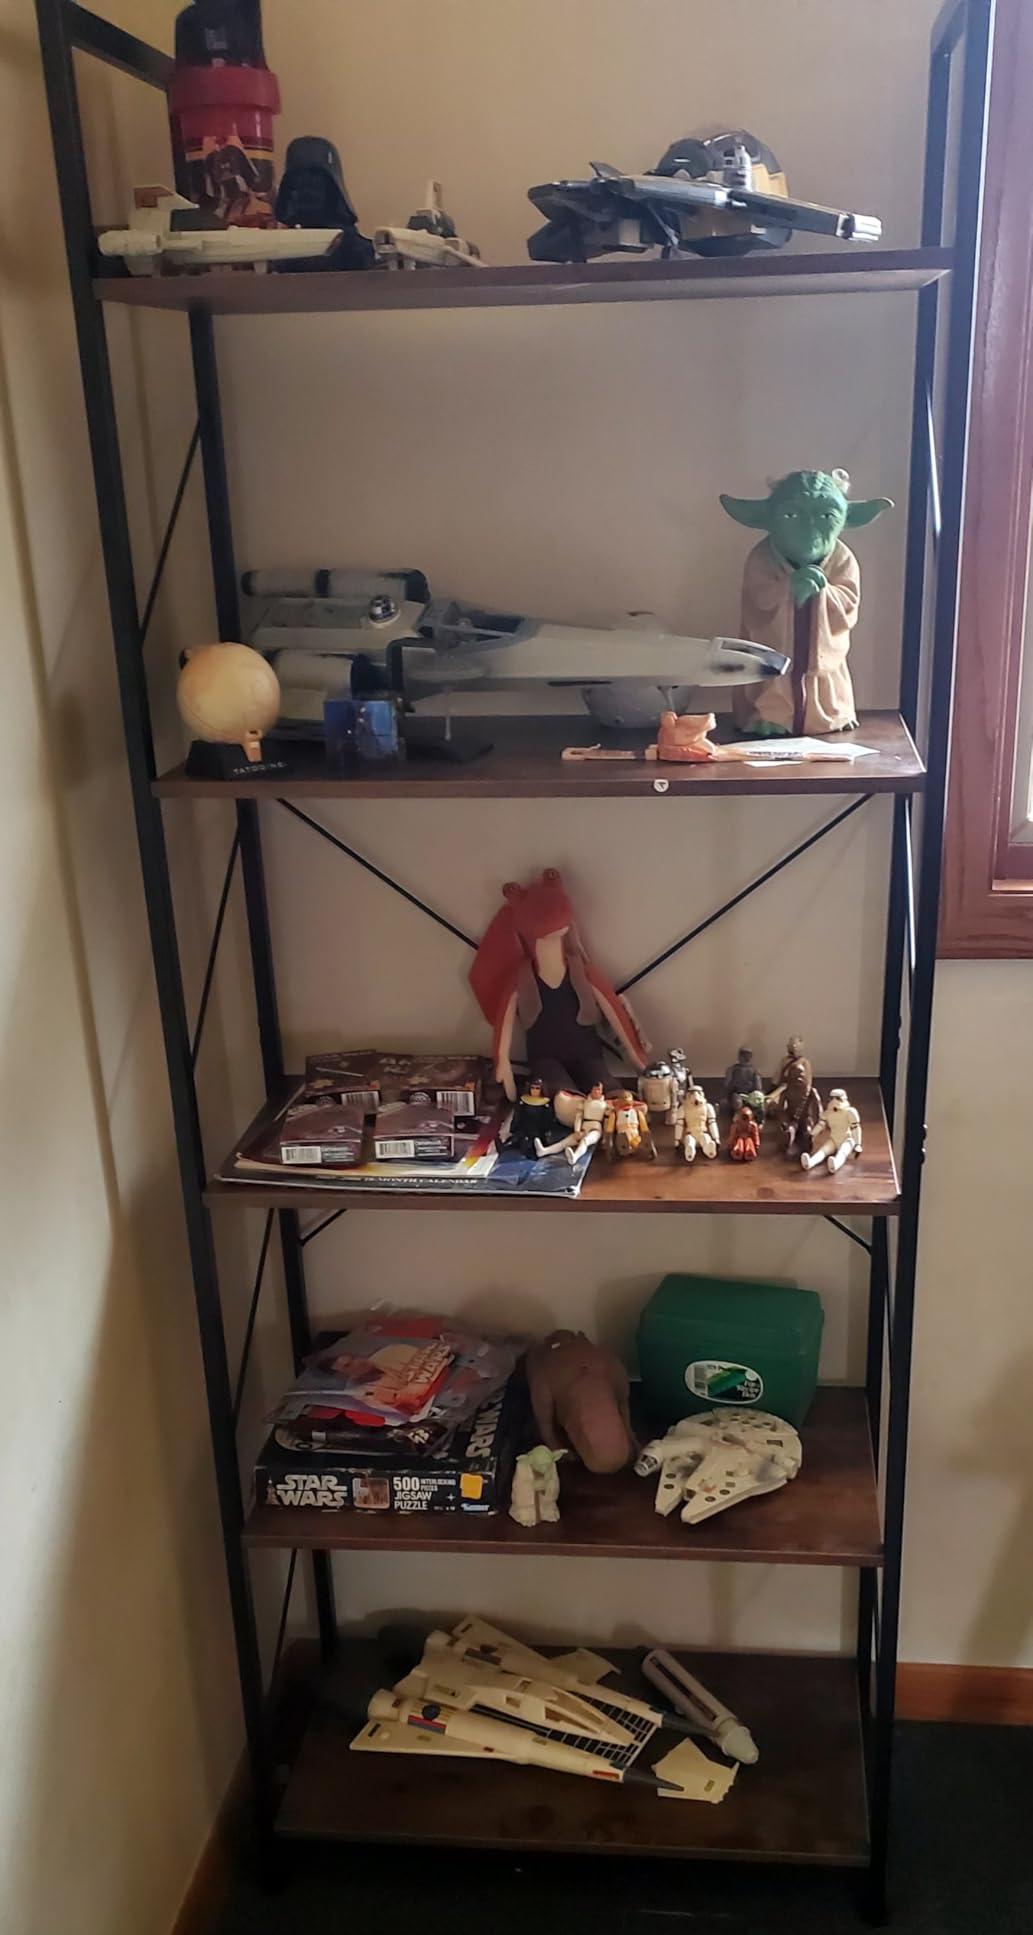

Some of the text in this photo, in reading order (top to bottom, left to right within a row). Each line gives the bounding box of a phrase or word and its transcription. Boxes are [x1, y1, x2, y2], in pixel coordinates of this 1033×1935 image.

[416, 1344, 450, 1382] WARS
[276, 1474, 348, 1491] STAR
[393, 1477, 420, 1491] 500
[276, 1490, 348, 1507] WARS
[394, 1491, 432, 1500] JIGSAW
[394, 1501, 428, 1510] PUZZLE
